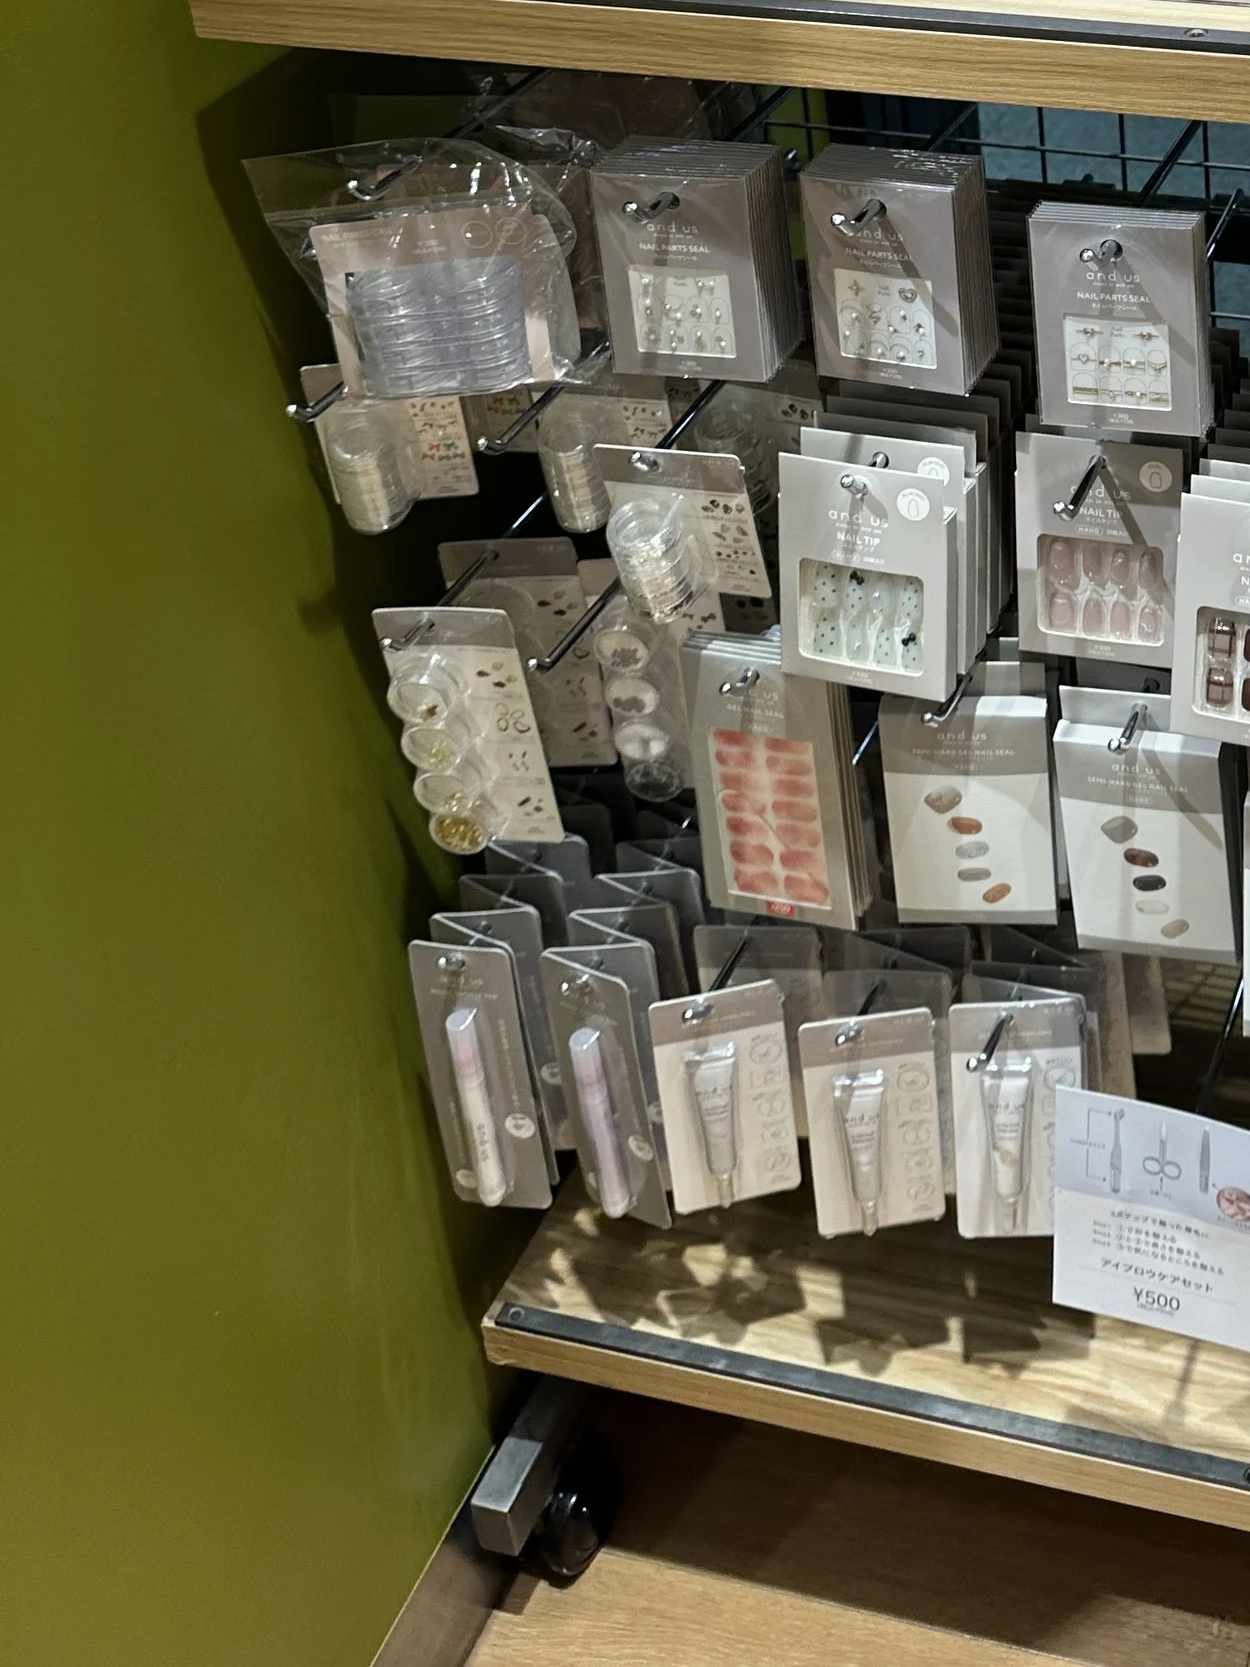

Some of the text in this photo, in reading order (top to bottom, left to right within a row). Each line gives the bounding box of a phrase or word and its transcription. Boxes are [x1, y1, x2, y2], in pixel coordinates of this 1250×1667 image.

[1086, 270, 1118, 283] and
[1076, 290, 1100, 301] NAIL
[1100, 292, 1129, 303] PARTS
[828, 508, 889, 528] and us
[837, 531, 882, 547] NAIL TIP
[1132, 1285, 1181, 1312] ¥500
